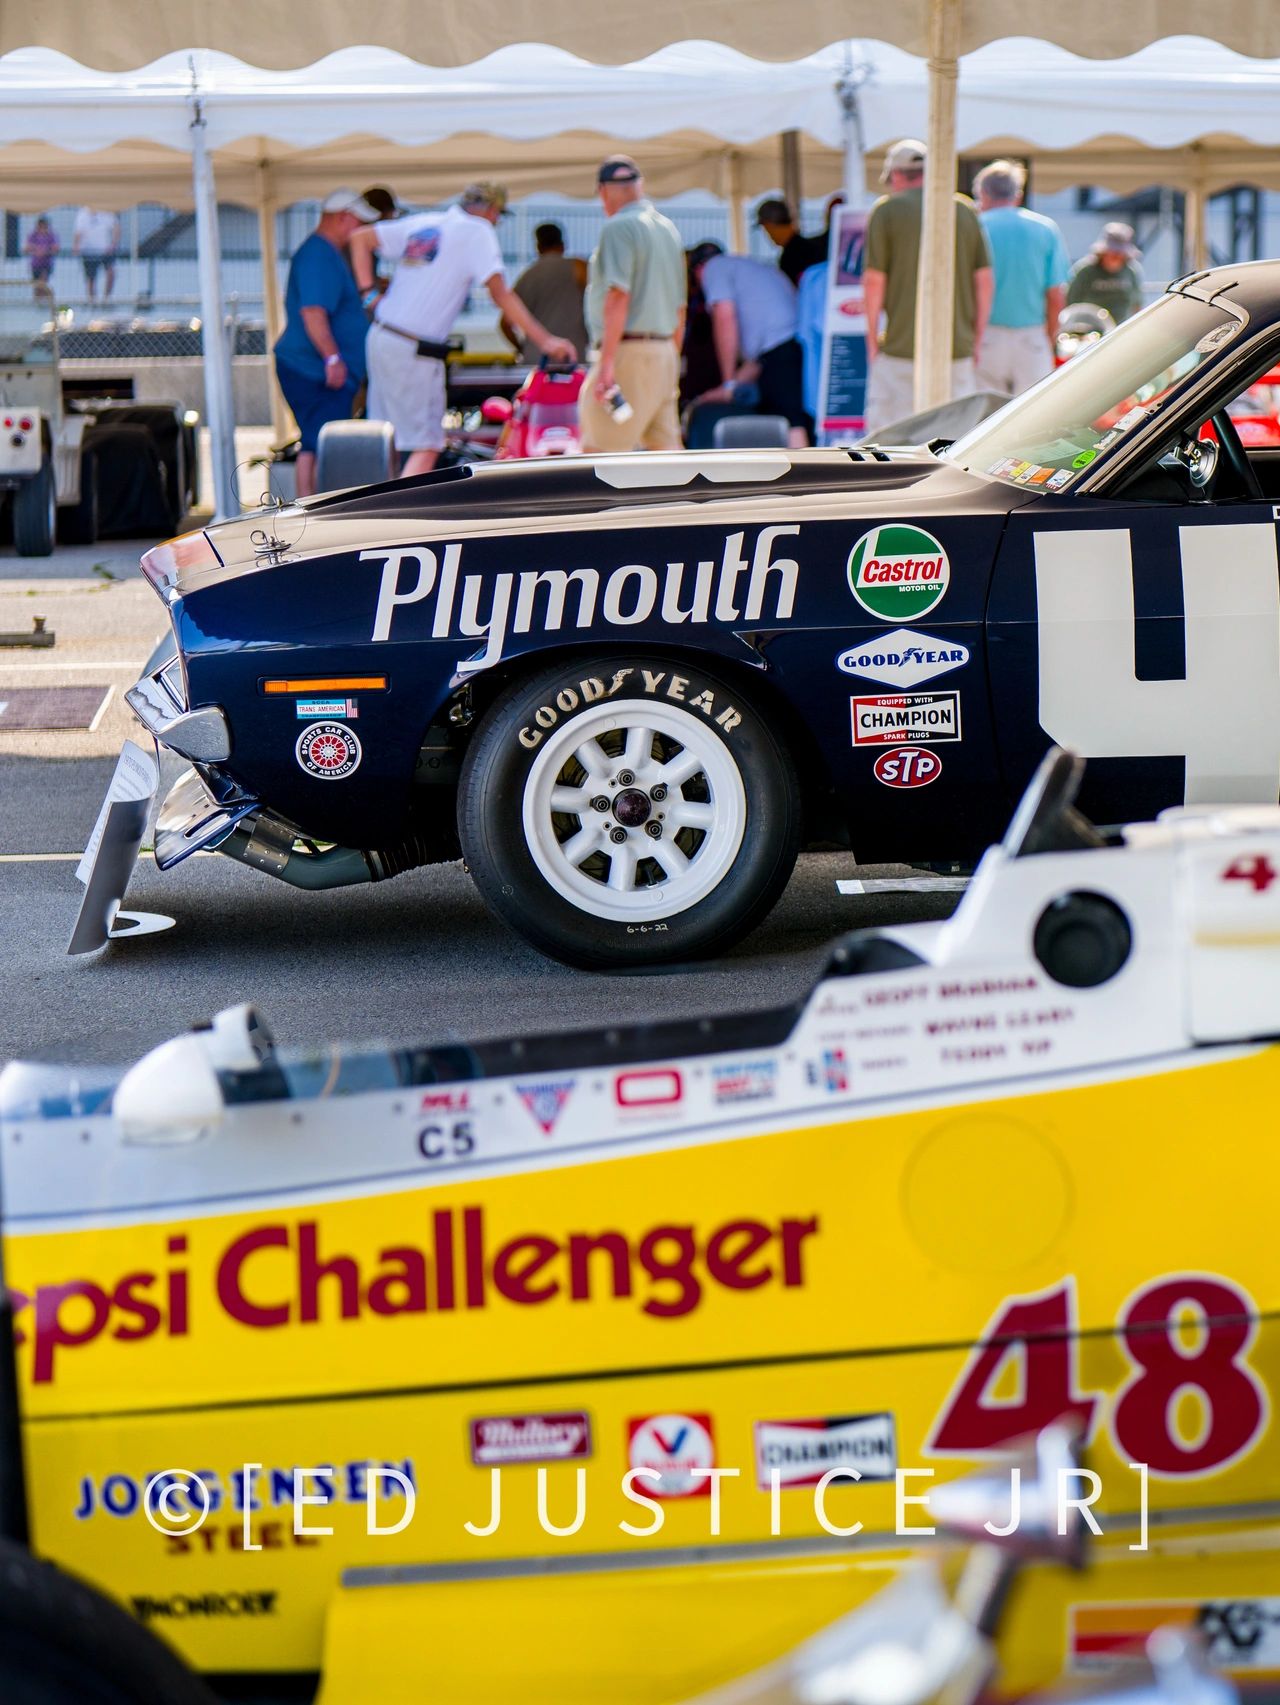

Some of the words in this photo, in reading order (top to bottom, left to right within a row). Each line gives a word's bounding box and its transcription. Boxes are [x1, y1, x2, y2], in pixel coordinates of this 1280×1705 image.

[863, 557, 943, 583] Castrol
[359, 525, 800, 672] Plymouth
[877, 697, 912, 705] EQUIPPED
[914, 696, 933, 704] WITH
[860, 709, 952, 728] CHAMPION
[302, 728, 322, 755] SPORTS
[325, 726, 343, 736] CAR
[343, 734, 356, 755] CLUB
[307, 761, 317, 771] OF
[318, 761, 353, 776] AMERICA
[881, 751, 934, 783] STP
[216, 1206, 820, 1327] Challenger
[921, 1273, 1271, 1482] 48
